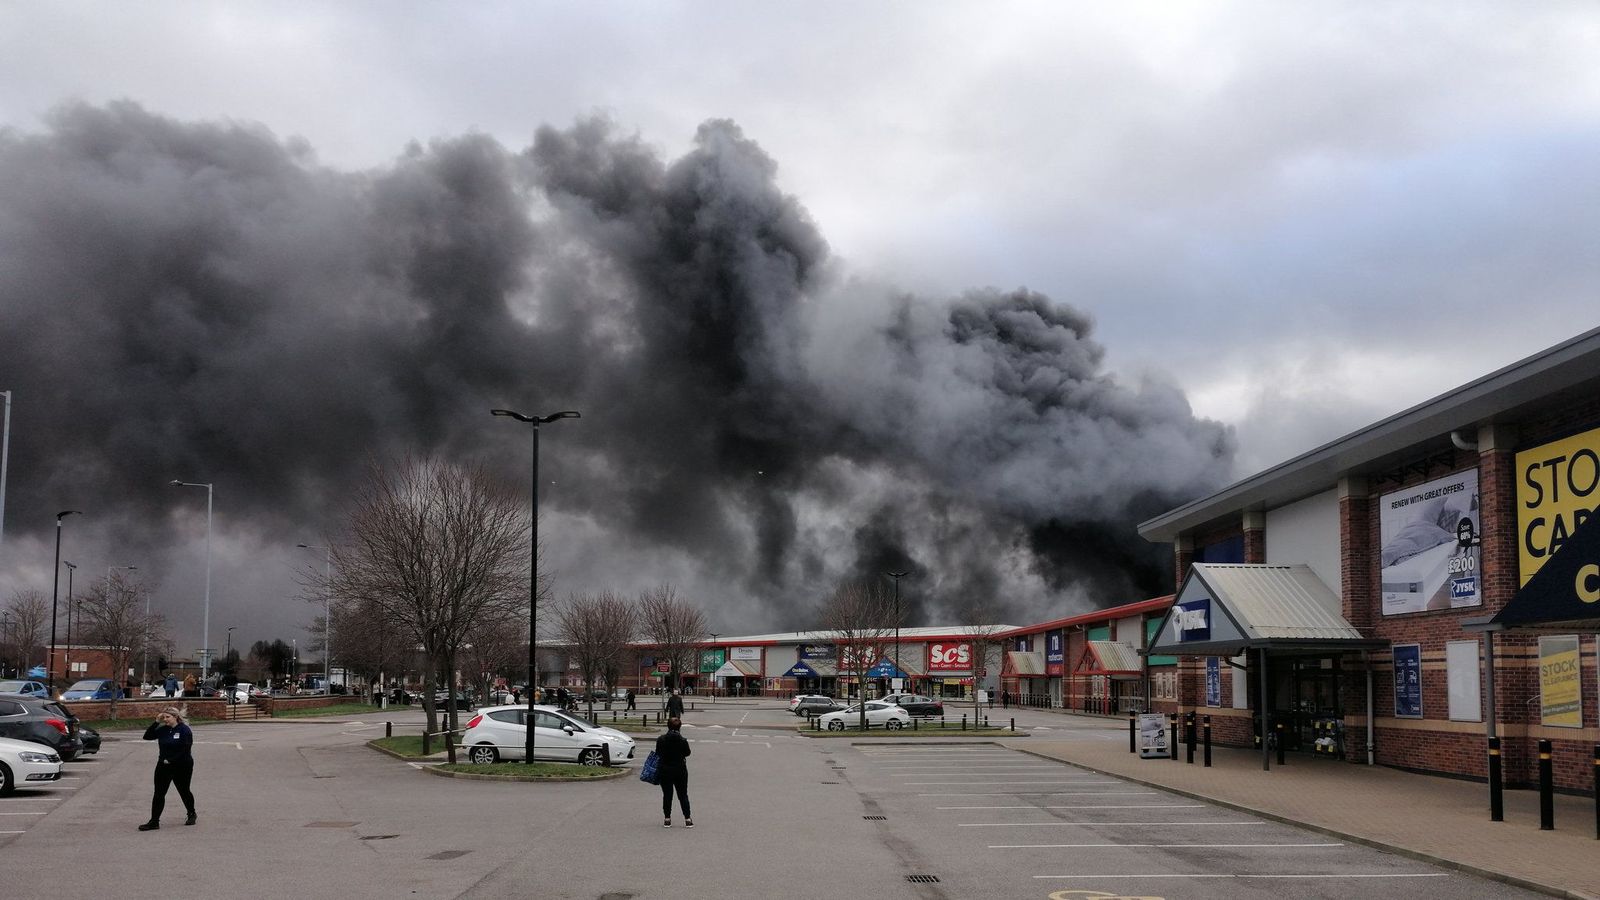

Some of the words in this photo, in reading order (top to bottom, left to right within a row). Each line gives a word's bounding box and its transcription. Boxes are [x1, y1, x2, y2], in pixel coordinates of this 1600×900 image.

[1391, 499, 1409, 510] RENEW
[1410, 494, 1424, 505] WITH
[1424, 489, 1442, 501] GREAT
[1442, 482, 1465, 496] OFFERS
[1448, 556, 1475, 574] £200
[1456, 581, 1475, 593] JYSK
[931, 644, 970, 664] ScS
[1542, 659, 1577, 677] STOCK
